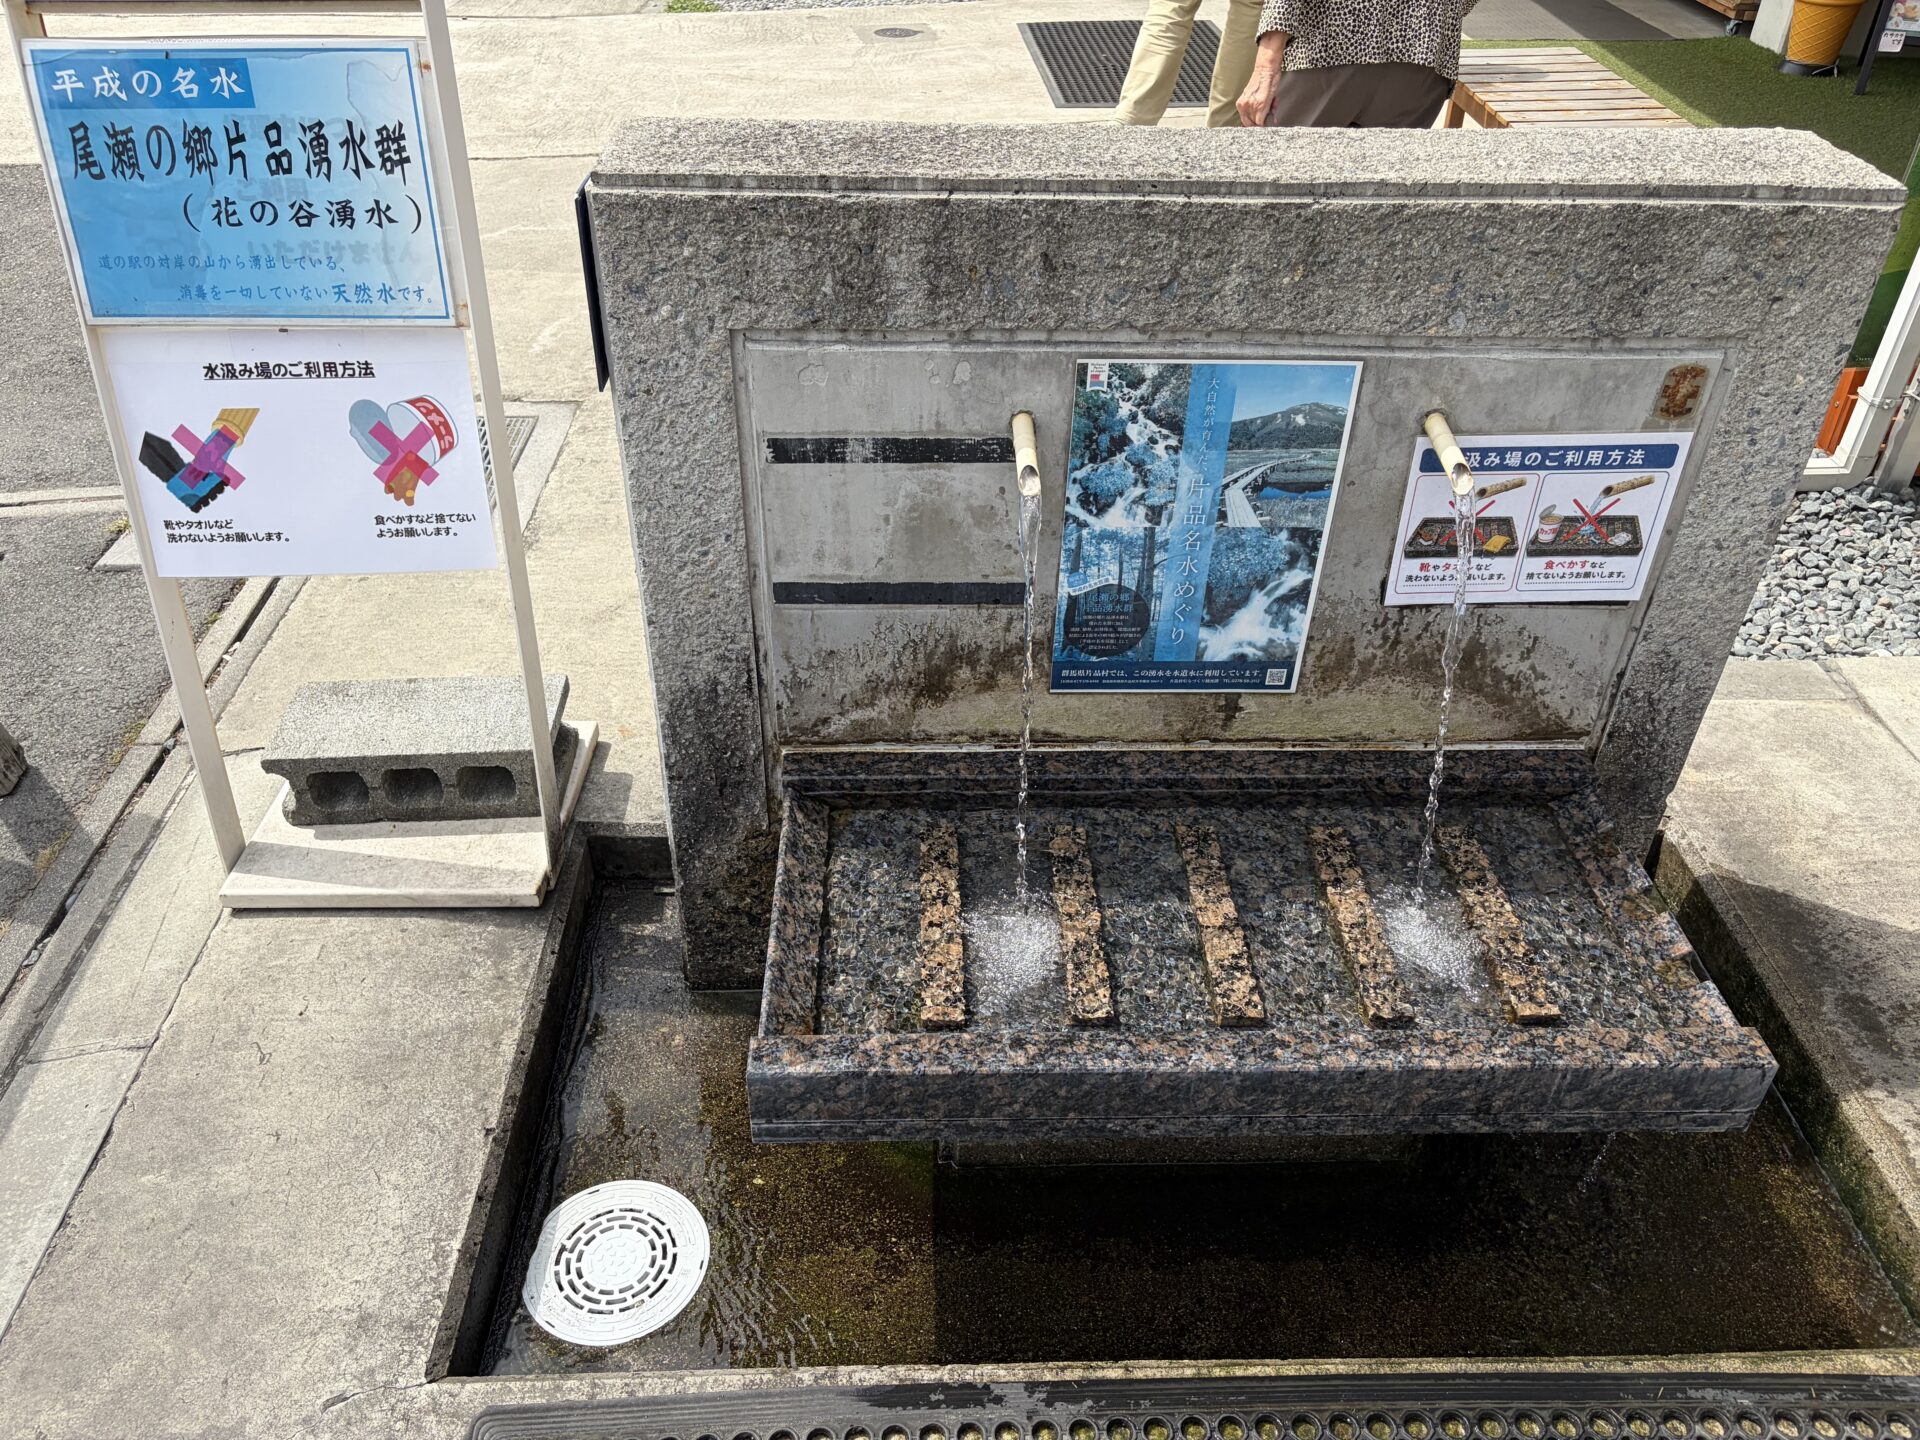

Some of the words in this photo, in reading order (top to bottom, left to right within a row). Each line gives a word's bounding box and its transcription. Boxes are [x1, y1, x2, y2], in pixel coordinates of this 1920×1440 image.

[52, 66, 245, 102] 平成の名水
[69, 119, 411, 186] 尾瀬の郷片品湧水群
[183, 193, 422, 234] （花の谷湧水）
[99, 253, 346, 272] 道の駅の対岸の山から湧出している、
[179, 283, 433, 304] 消毒を一切していない天然水です。
[203, 360, 376, 379] 水汲み場のご利用方法
[1463, 448, 1646, 469] 汲み場のご利用方法
[163, 519, 234, 530] 靴やタオルなど
[374, 512, 476, 525] 食べかすなど捨てない
[166, 531, 290, 544] 洗わないようお願いします。
[377, 526, 458, 538] ようお願いします。
[1171, 478, 1211, 646] 片品名水めぐり
[1543, 559, 1607, 570] 食べかすなど
[1525, 570, 1627, 581] 捨てないようお願いします。
